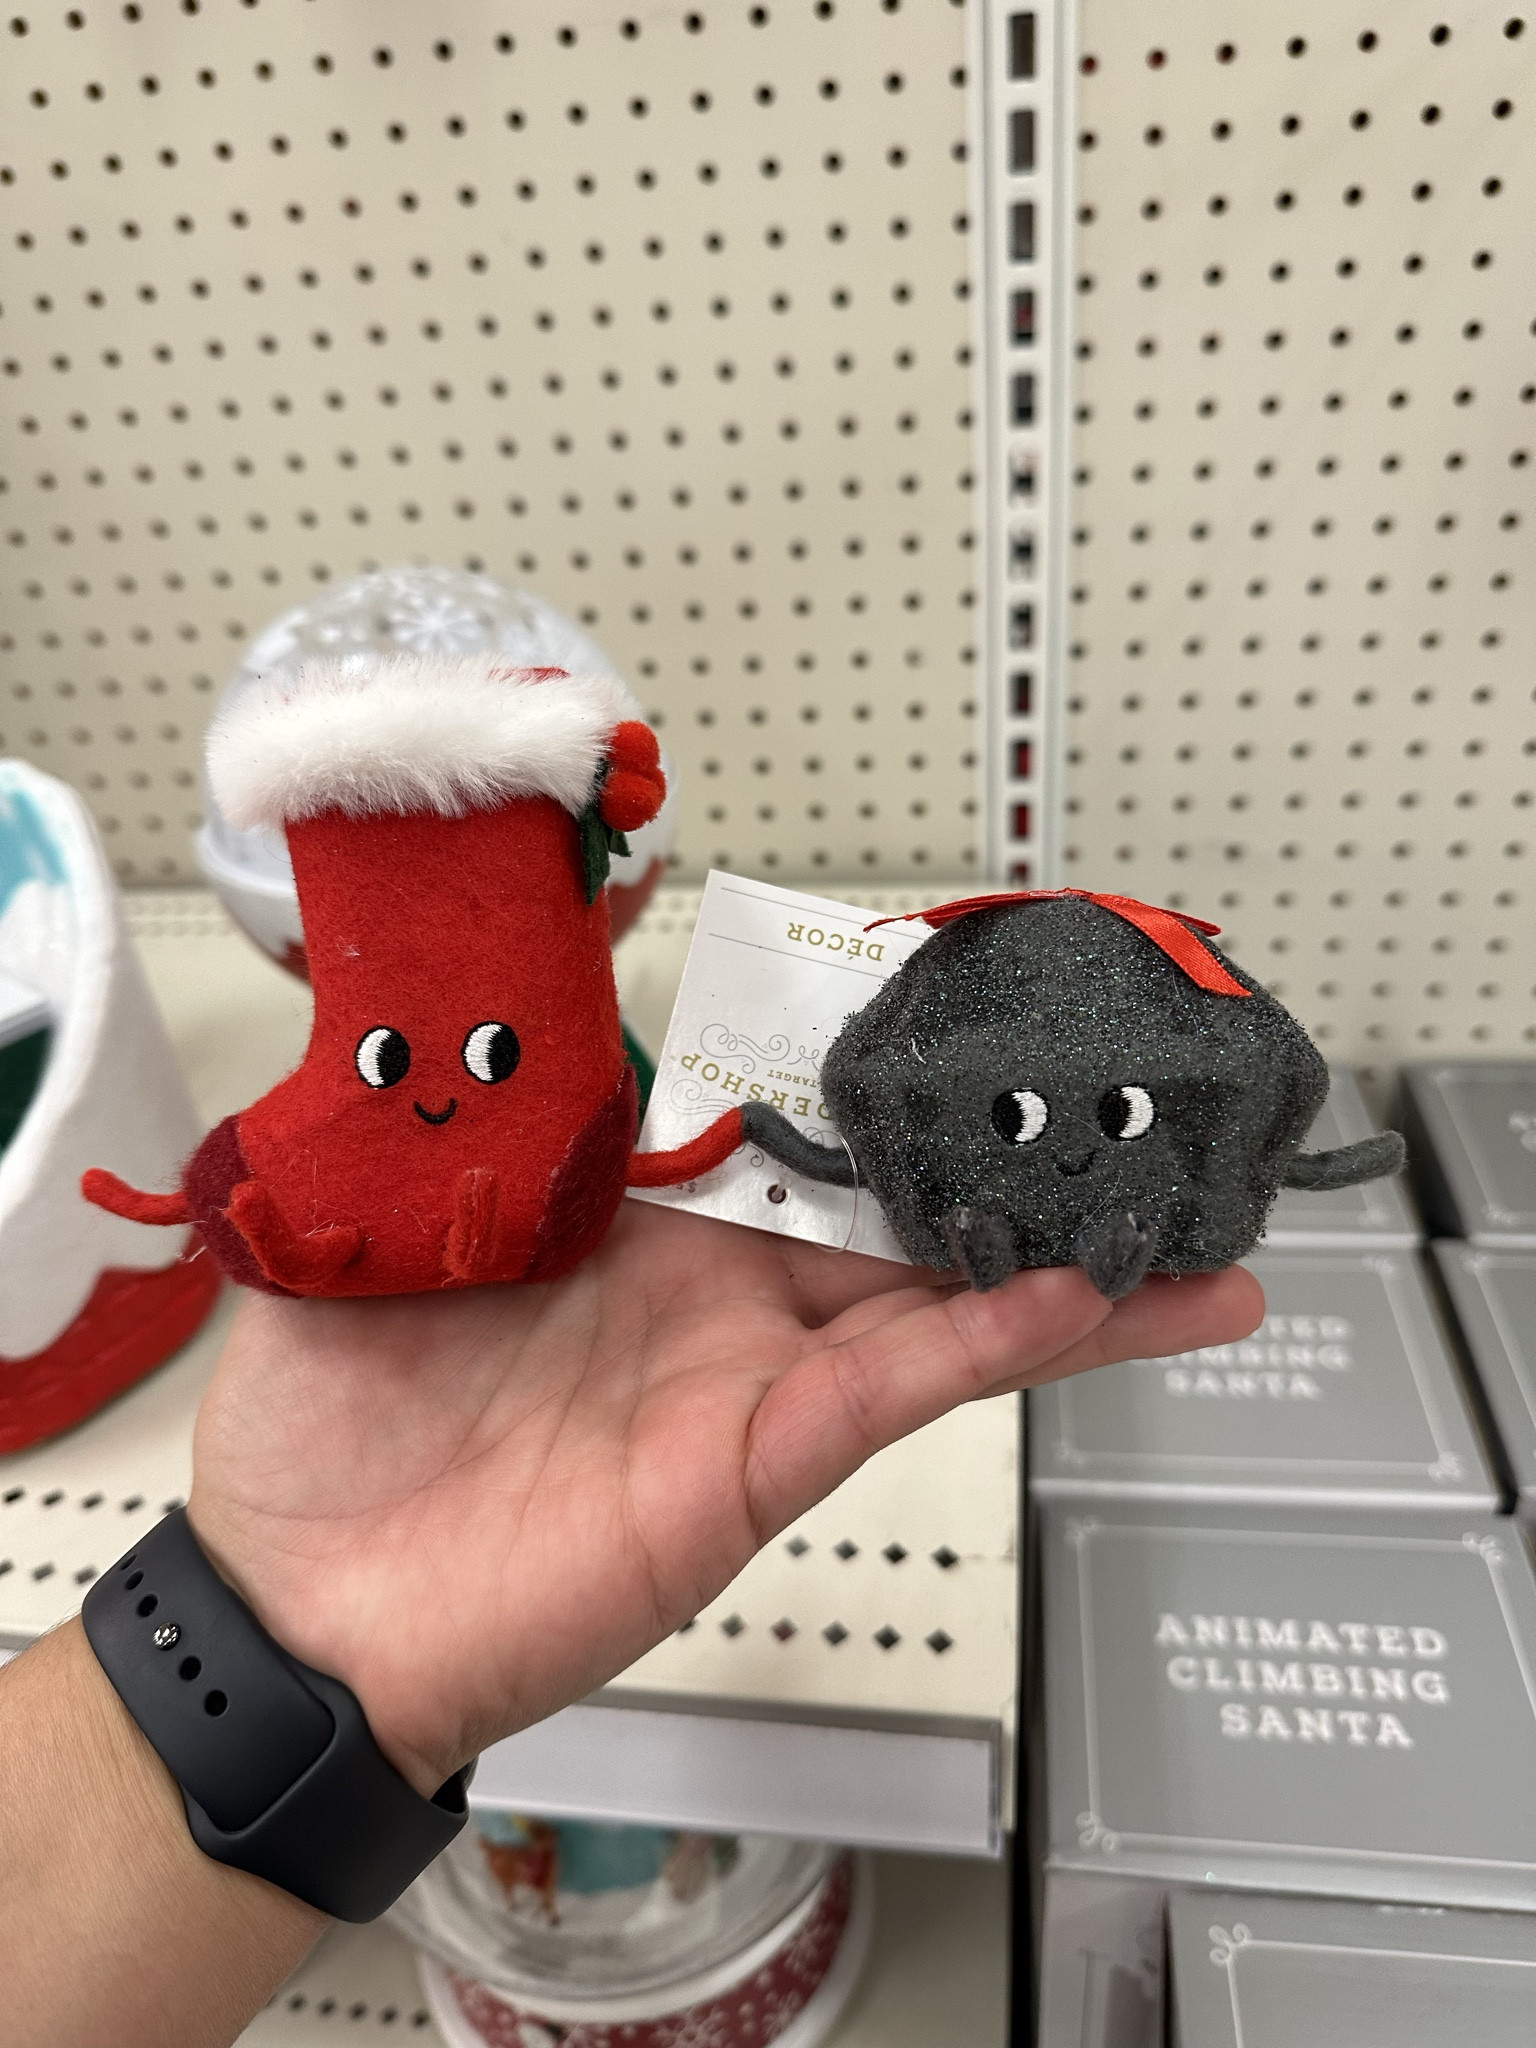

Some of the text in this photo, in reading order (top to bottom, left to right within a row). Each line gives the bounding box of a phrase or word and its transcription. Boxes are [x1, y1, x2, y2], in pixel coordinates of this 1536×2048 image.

[787, 922, 885, 961] DÉCOR
[680, 1053, 834, 1121] DERSHOP
[767, 1069, 820, 1088] TARGET
[1164, 1368, 1322, 1399] SANTA
[1154, 1613, 1448, 1659] ANIMATED
[1166, 1655, 1450, 1704] CLIMBING
[1218, 1702, 1415, 1748] SANTA
